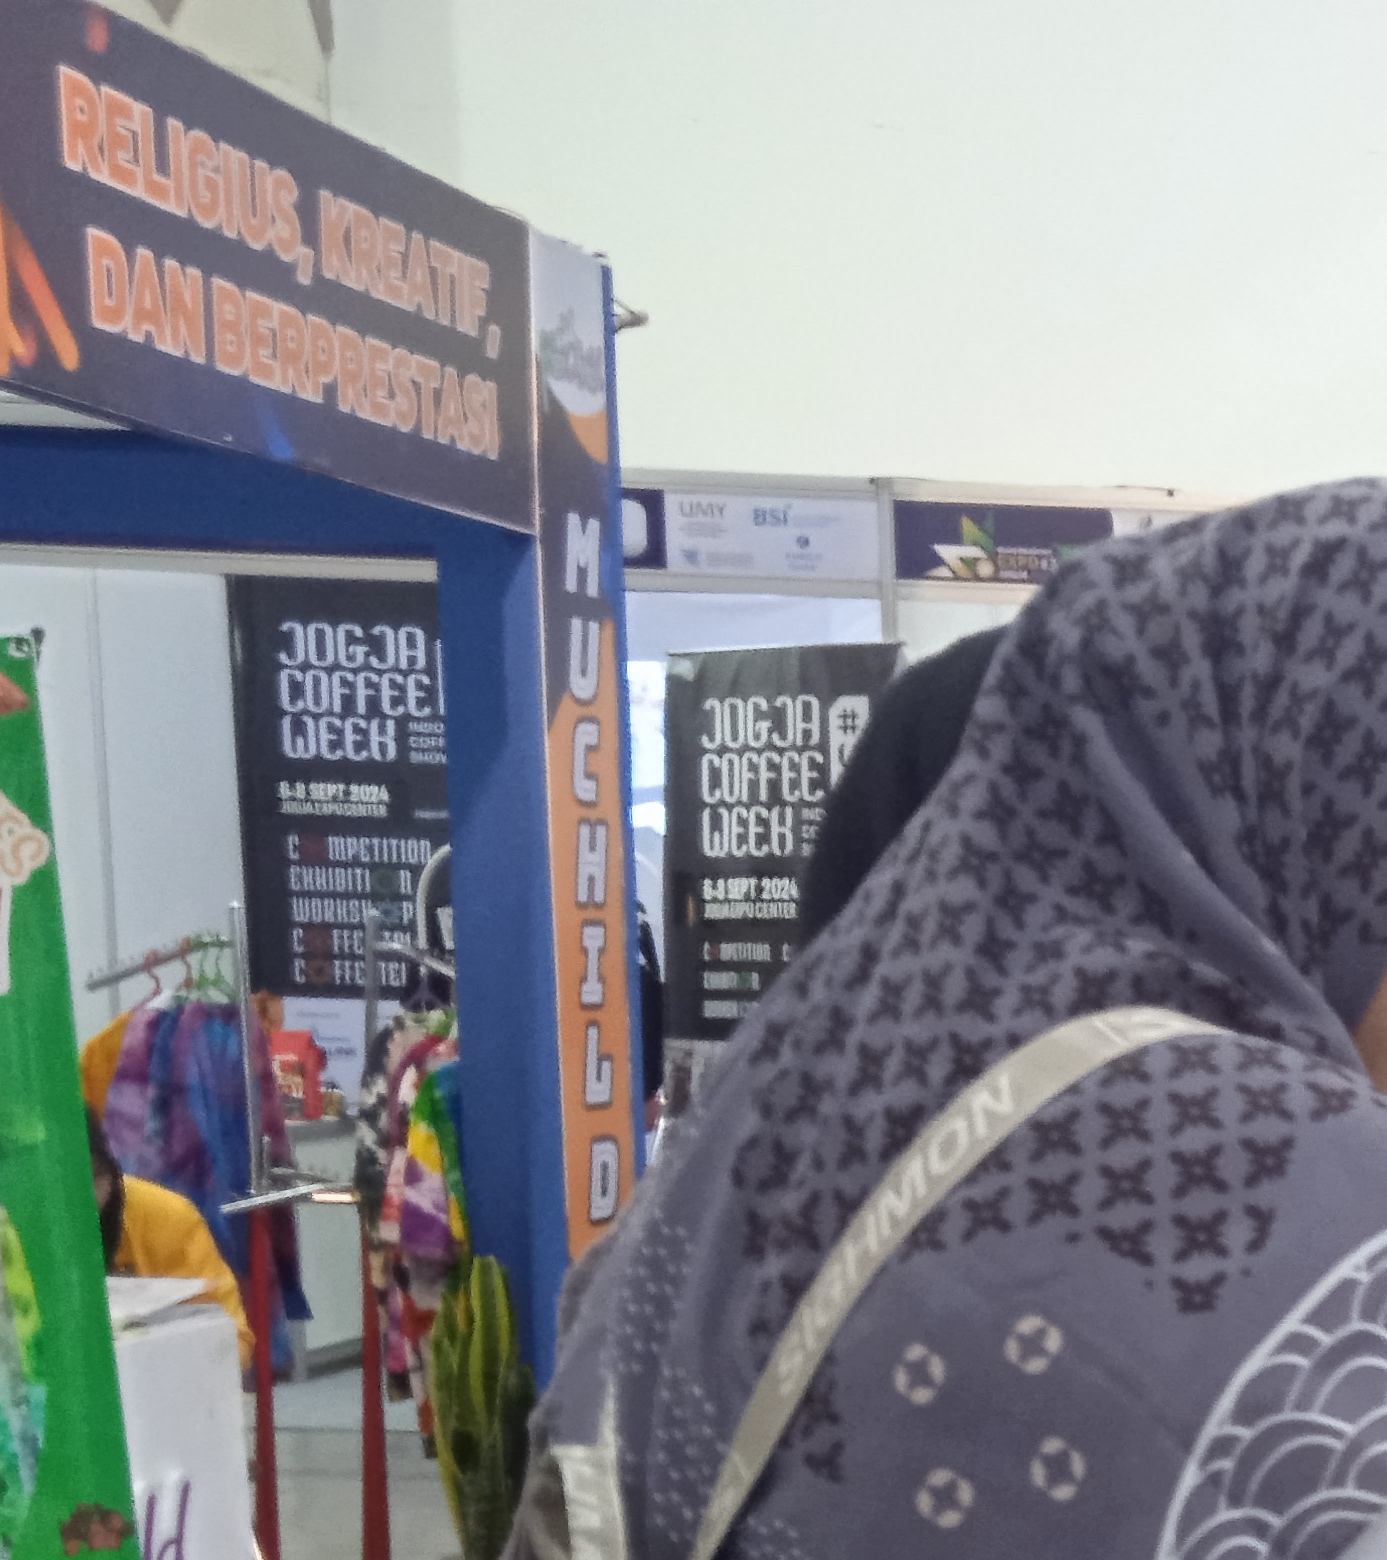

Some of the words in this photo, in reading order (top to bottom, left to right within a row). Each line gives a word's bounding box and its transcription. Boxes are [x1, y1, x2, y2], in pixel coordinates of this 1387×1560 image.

[58, 65, 314, 284] RELIGIUS,
[87, 227, 205, 364] DAN
[212, 275, 499, 460] BERPRESTASI
[278, 621, 427, 670] JOGJA
[279, 669, 432, 718] COFFEE
[281, 714, 398, 762] WEEK
[701, 694, 821, 750] JOGJA
[701, 750, 825, 803] COFFEE
[702, 804, 794, 858] WEEK
[566, 509, 620, 1225] MUCHILD
[760, 876, 799, 900] 2024
